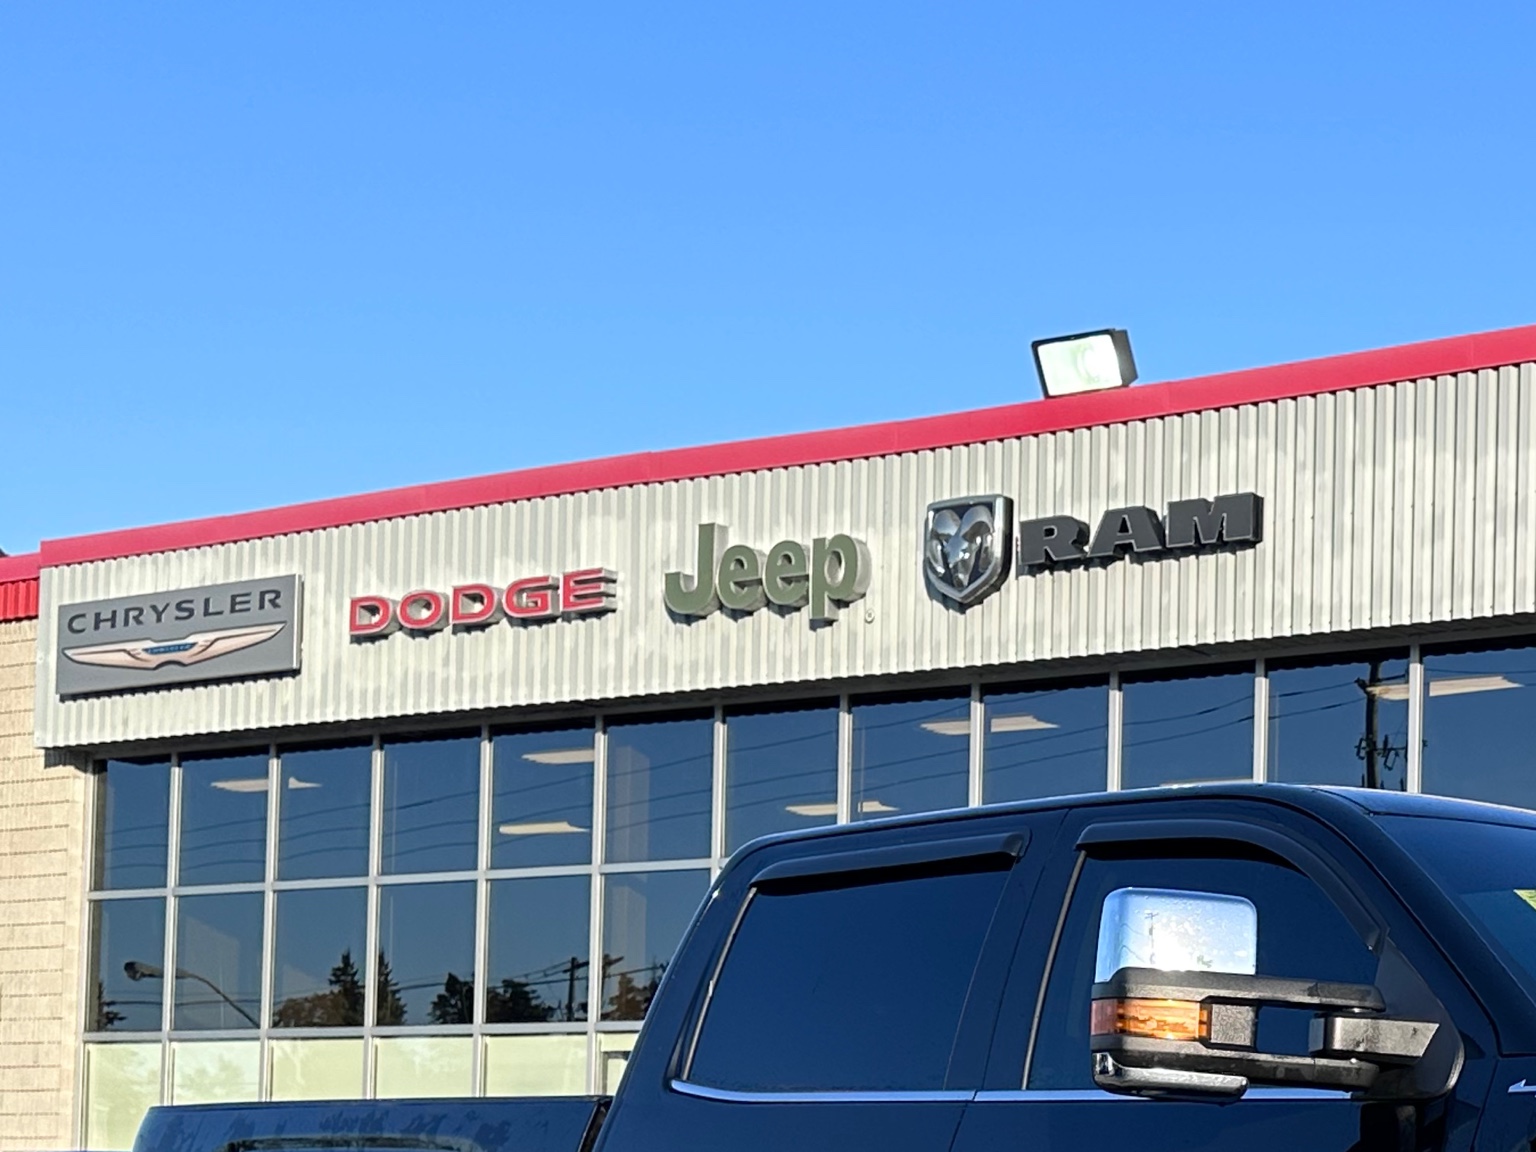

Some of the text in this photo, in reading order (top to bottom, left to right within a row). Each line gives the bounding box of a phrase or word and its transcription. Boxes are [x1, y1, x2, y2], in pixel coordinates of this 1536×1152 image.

[1019, 492, 1263, 566] RAM
[350, 567, 616, 636] DODGE
[663, 522, 871, 622] Jeep
[67, 589, 282, 634] CHRYSLER
